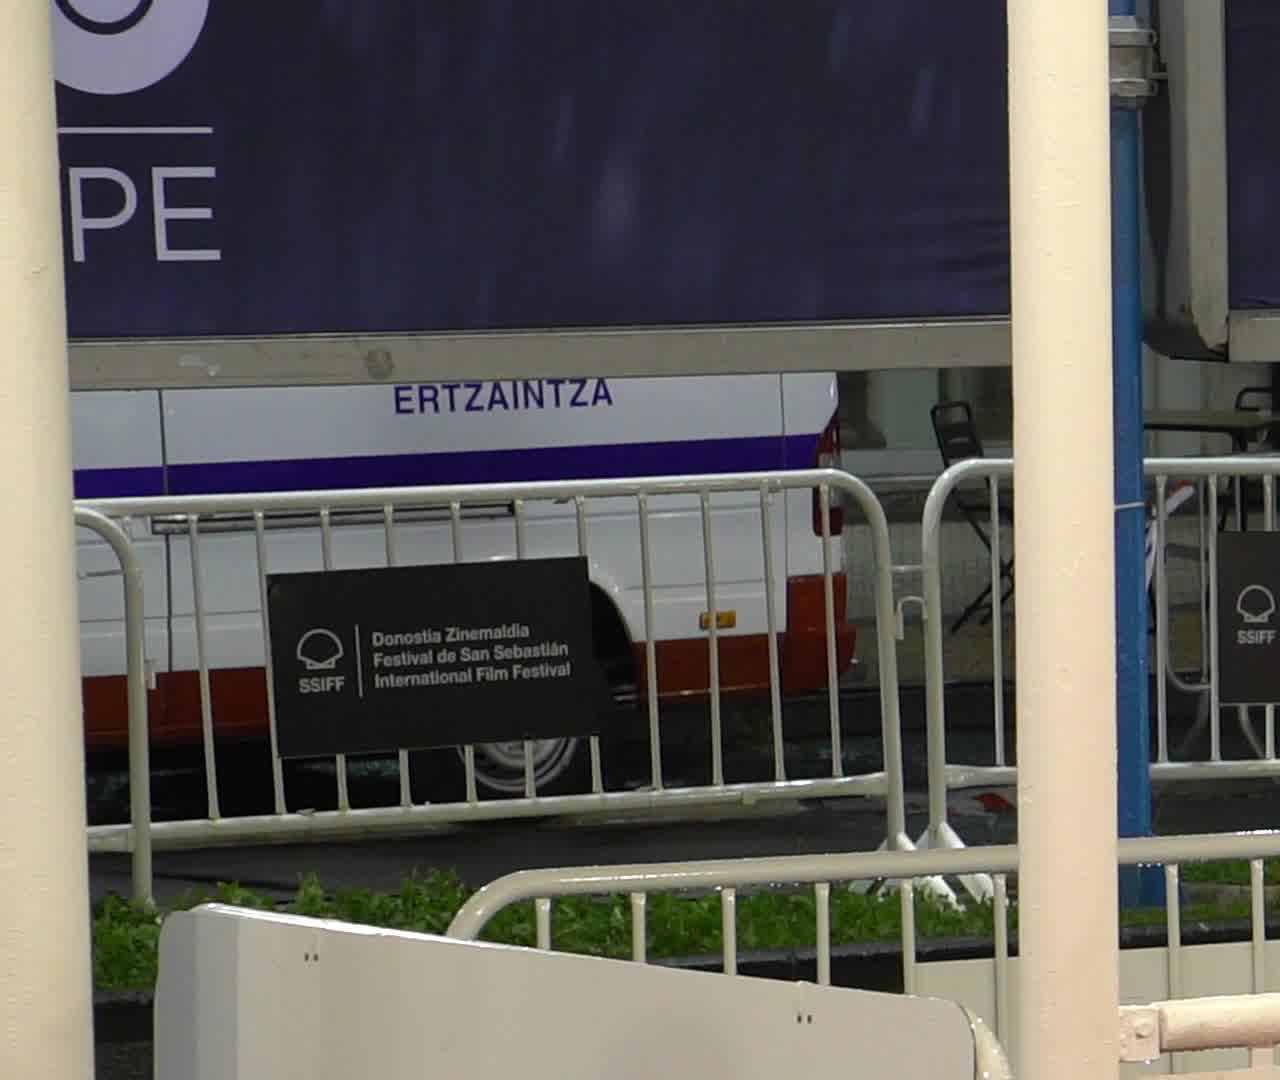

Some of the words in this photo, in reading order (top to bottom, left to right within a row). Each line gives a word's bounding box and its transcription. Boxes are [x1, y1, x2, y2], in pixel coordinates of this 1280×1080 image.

[393, 377, 614, 415] ERTZAINTZA
[371, 626, 441, 648] Donostia
[445, 623, 530, 643] Zinemaldia
[1236, 629, 1277, 646] SSIFF
[373, 648, 434, 669] Festival
[436, 646, 457, 664] de
[460, 645, 490, 663] San
[493, 640, 569, 661] Sebastián
[299, 675, 345, 694] SSIFF
[374, 668, 473, 689] International
[475, 664, 509, 682] Film
[512, 660, 571, 680] Festival
